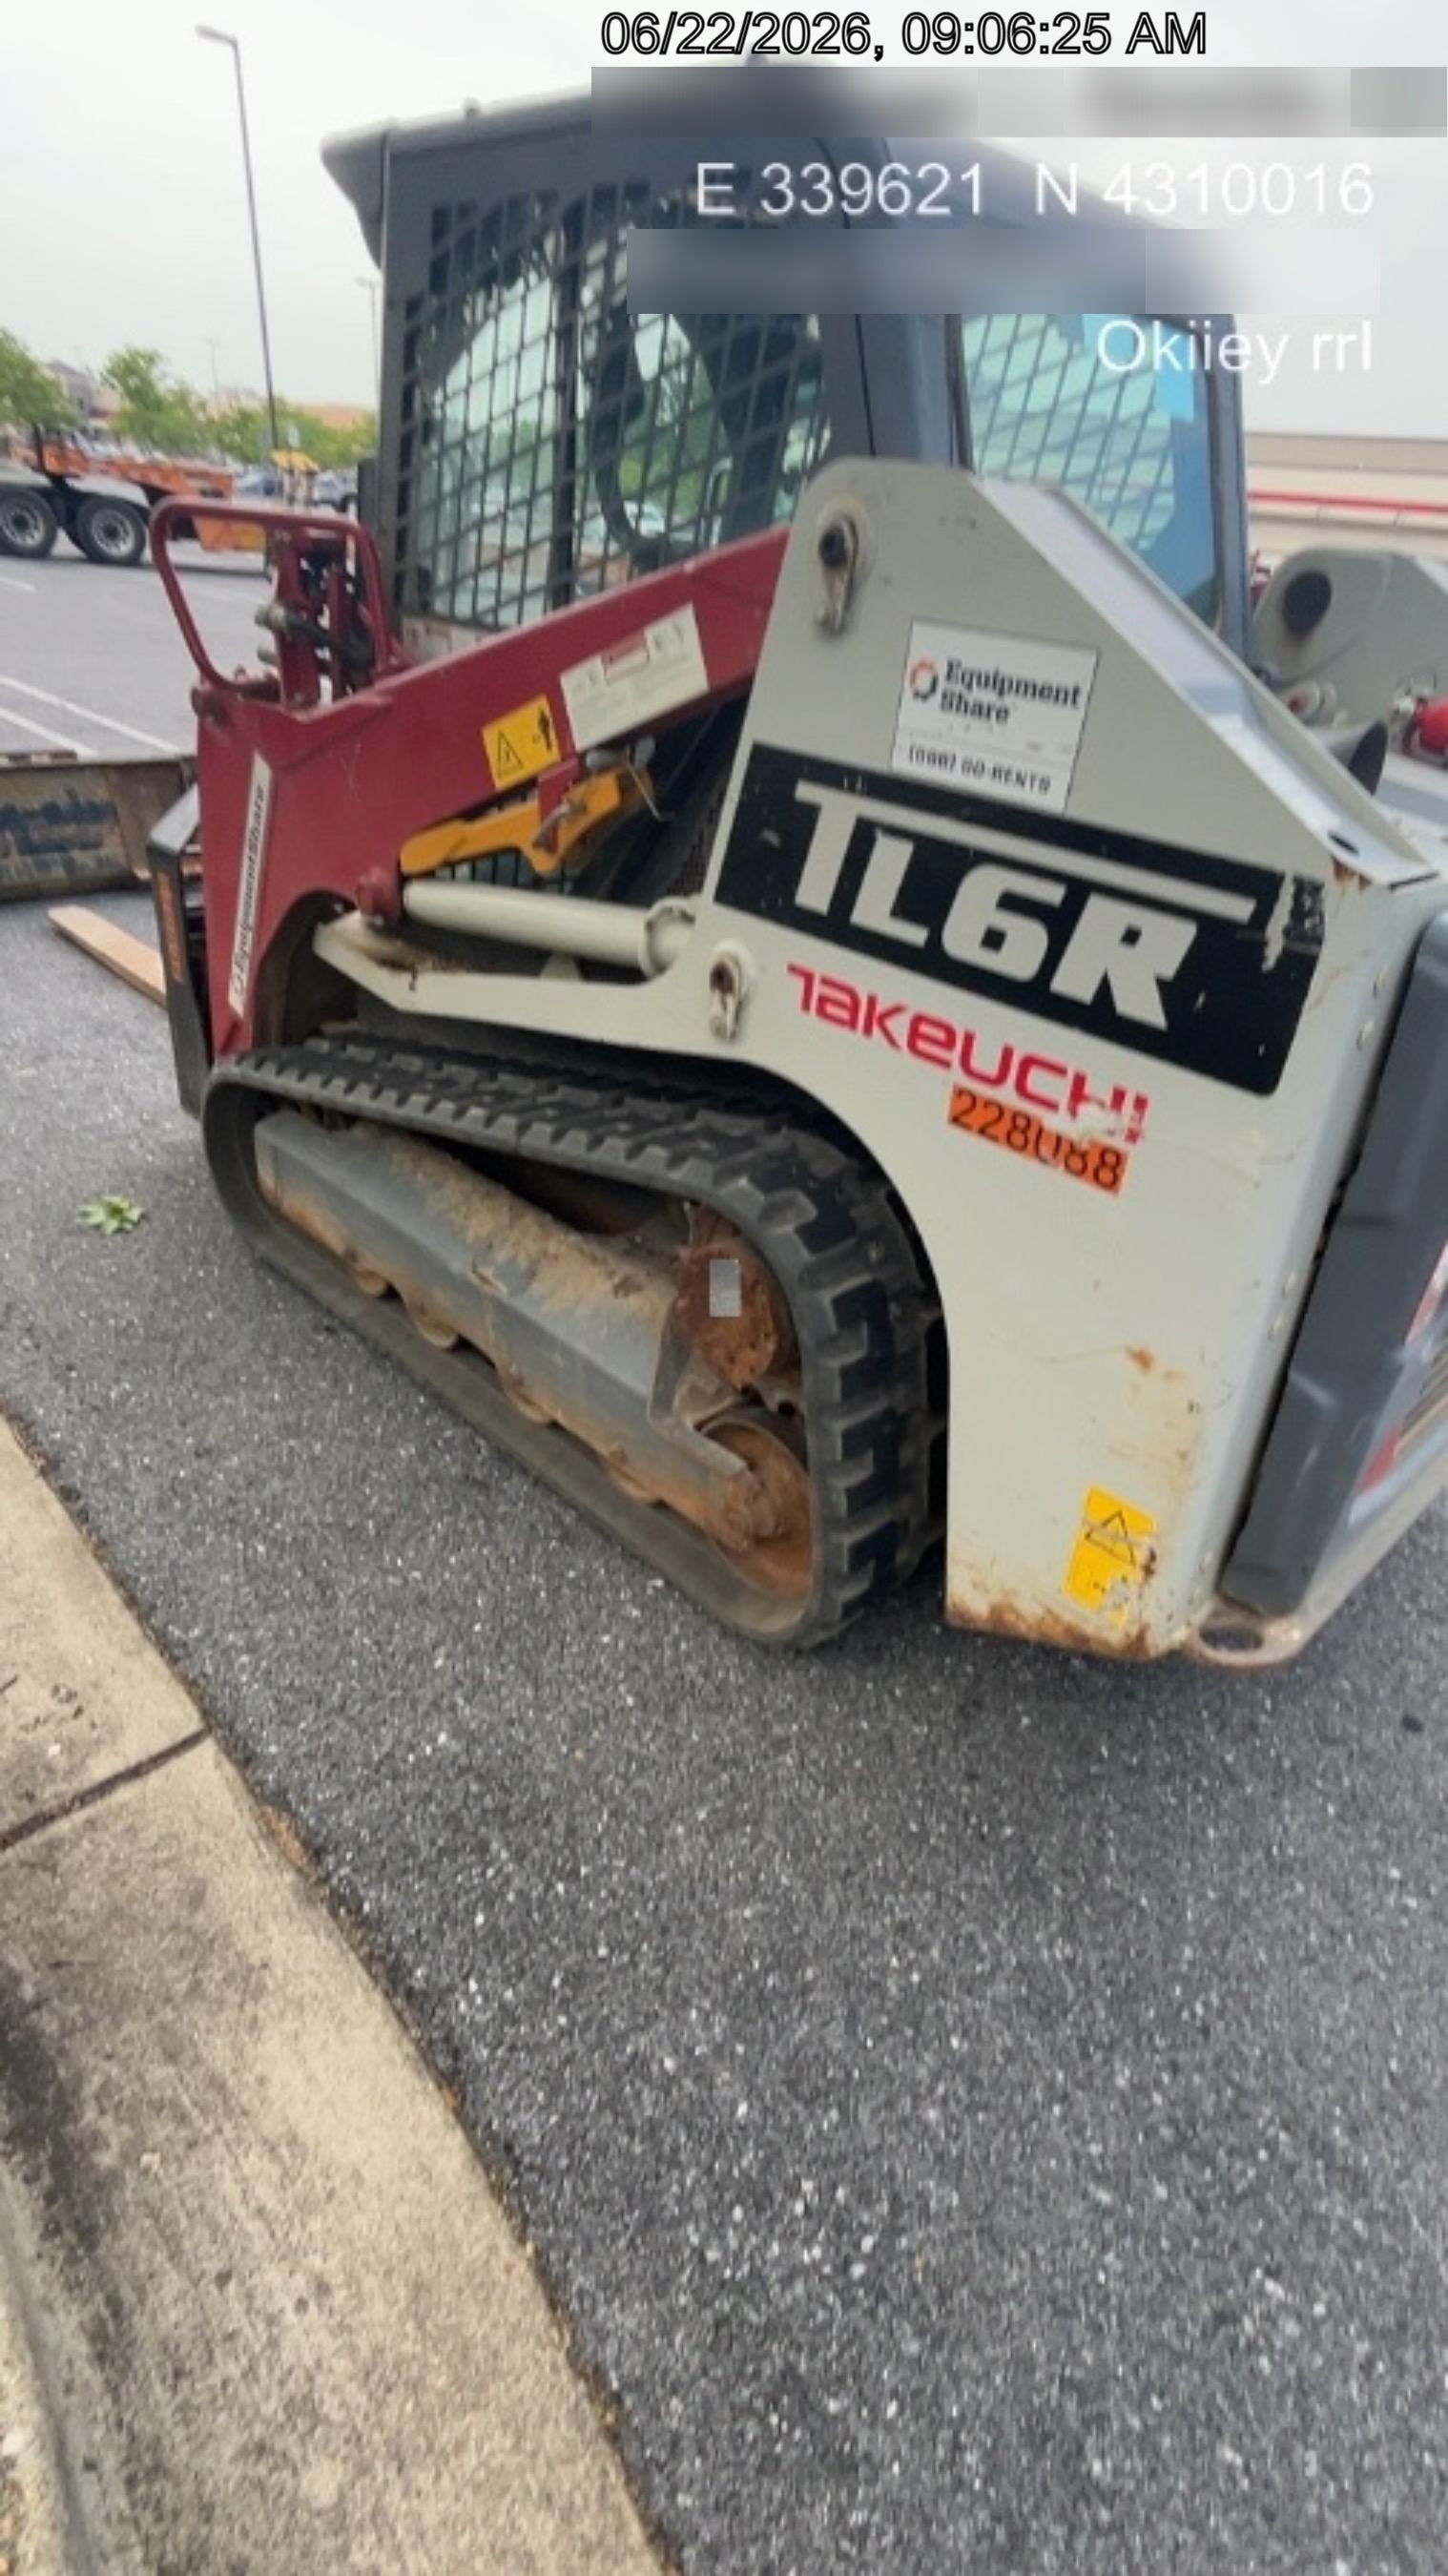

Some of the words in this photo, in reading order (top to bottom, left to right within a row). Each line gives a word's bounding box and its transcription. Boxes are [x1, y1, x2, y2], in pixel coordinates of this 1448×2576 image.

[940, 689, 1010, 725] Share
[946, 656, 1081, 710] Equipment
[795, 779, 1257, 1032] TL6R
